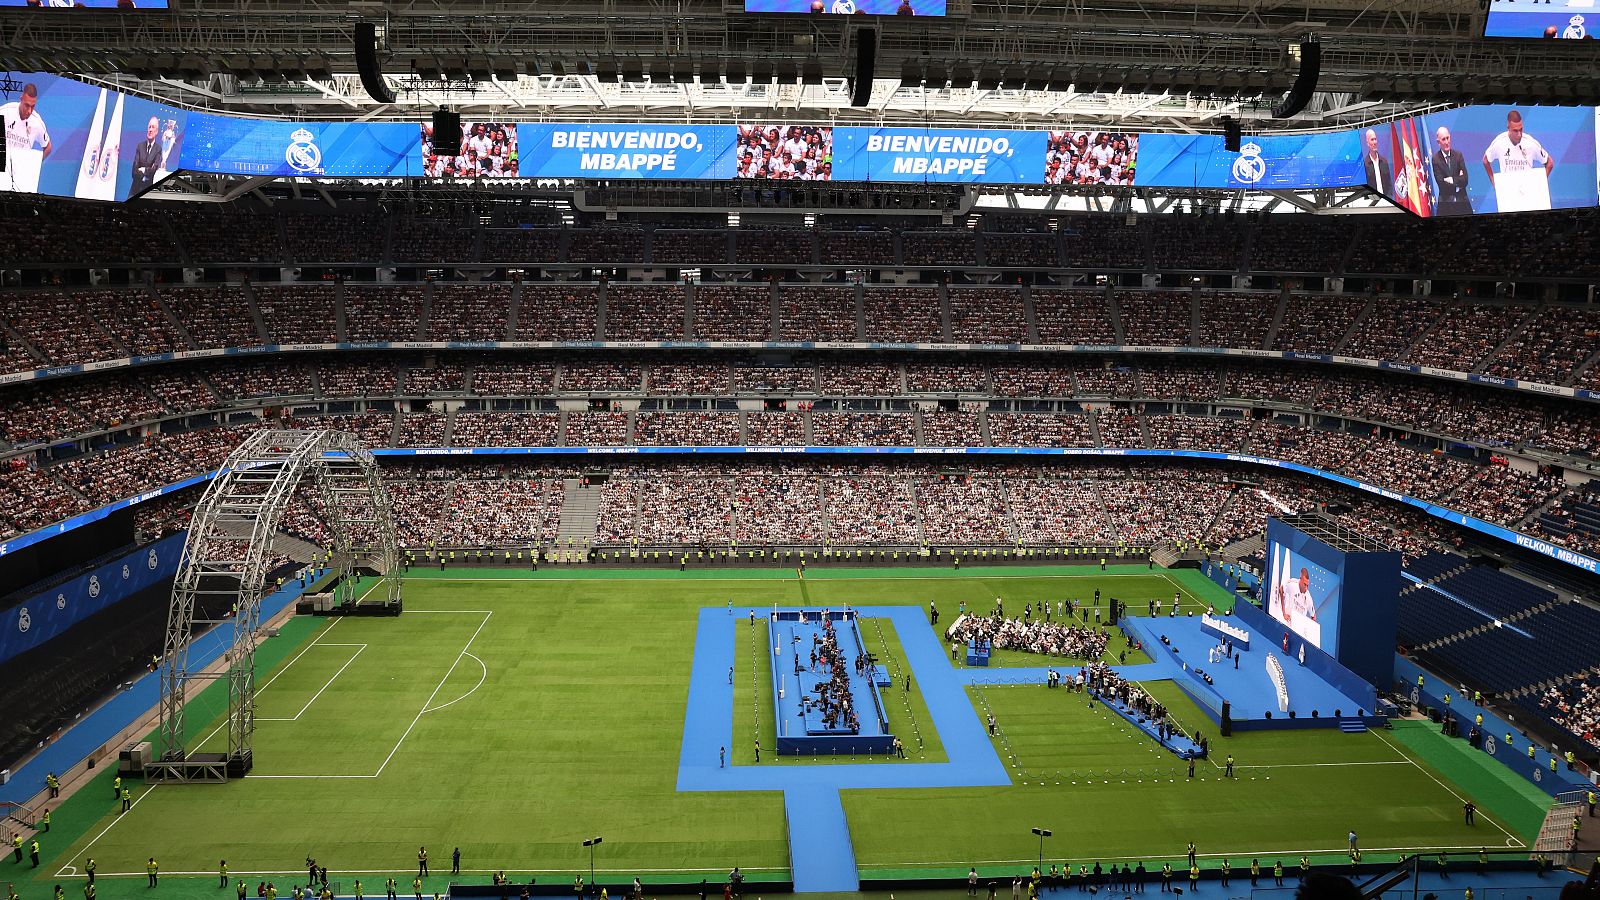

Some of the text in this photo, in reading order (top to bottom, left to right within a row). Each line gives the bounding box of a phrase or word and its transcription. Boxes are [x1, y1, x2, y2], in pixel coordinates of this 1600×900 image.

[552, 130, 703, 153] BIENVENIDO,
[866, 134, 1014, 158] BIENVENIDO,
[580, 150, 676, 171] MBAPPÉ
[893, 155, 988, 175] MBAPPÉ
[1516, 534, 1556, 557] WELKOM,
